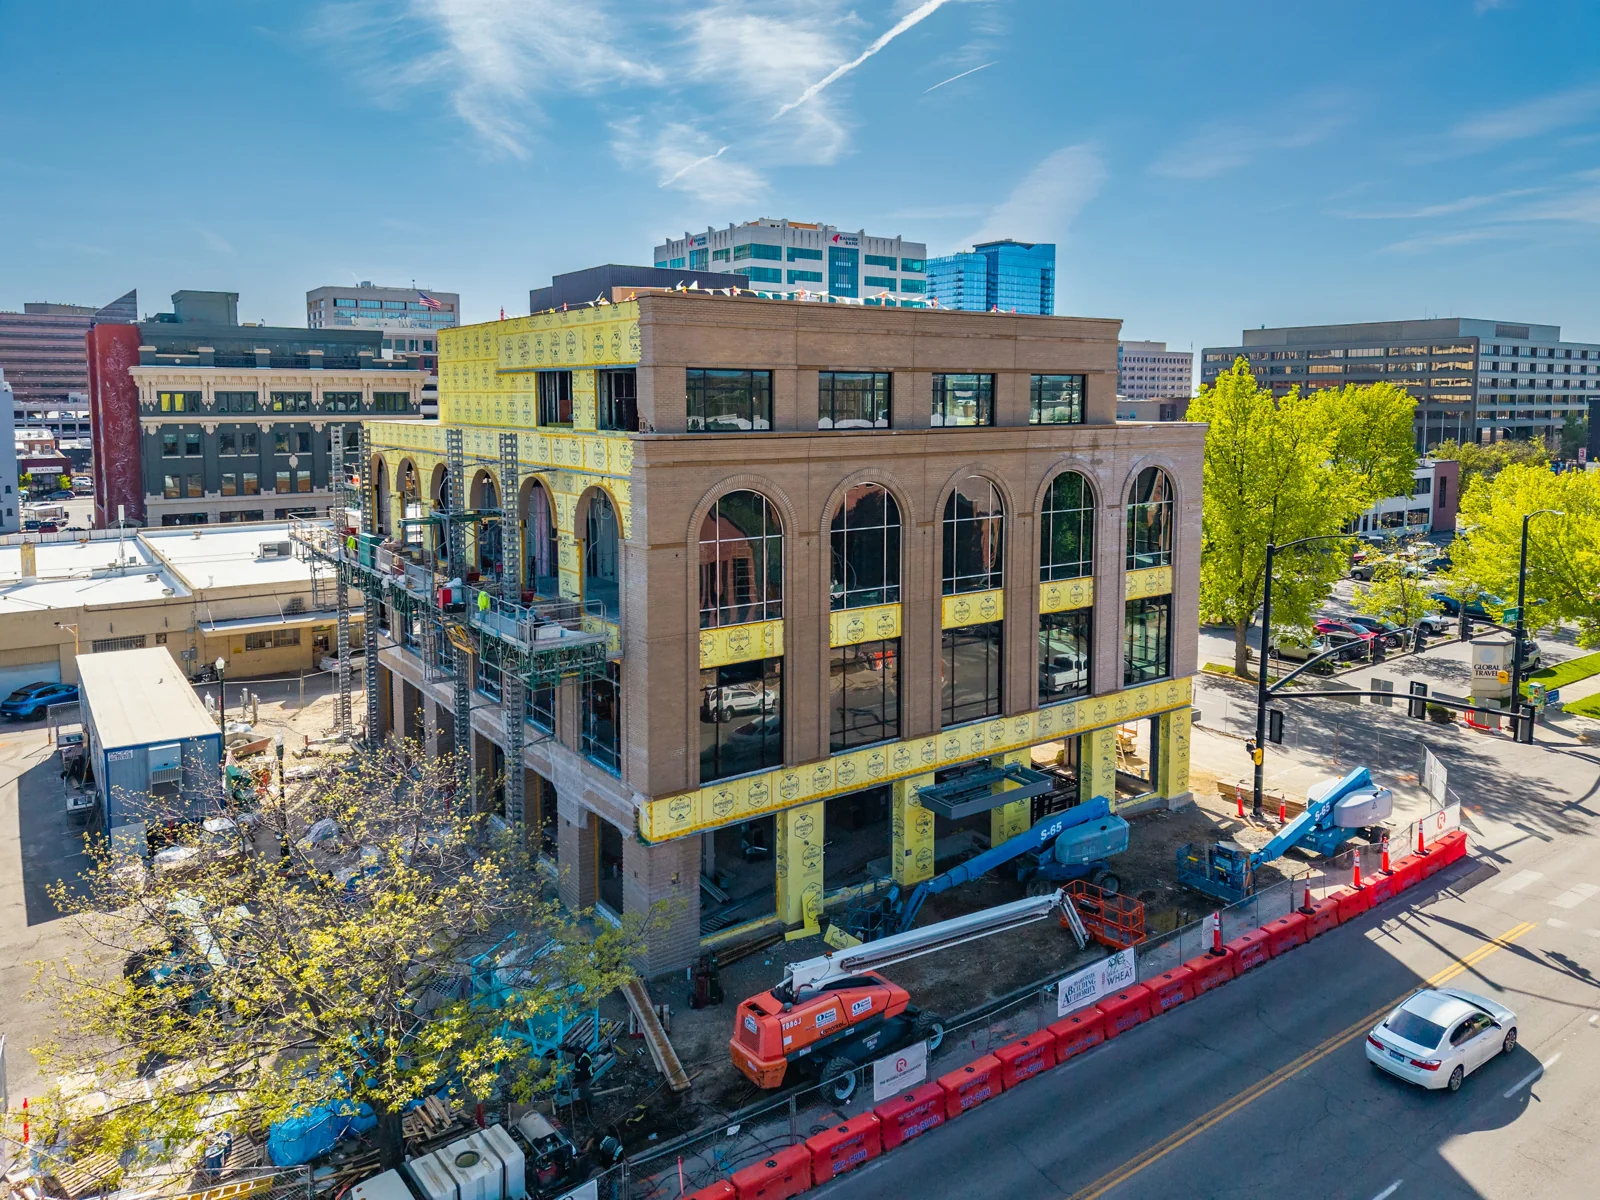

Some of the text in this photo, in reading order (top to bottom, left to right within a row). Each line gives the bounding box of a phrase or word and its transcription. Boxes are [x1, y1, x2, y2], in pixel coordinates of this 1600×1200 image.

[1315, 802, 1331, 821] S-65
[1040, 821, 1062, 840] S-65
[1107, 967, 1133, 986] WHEAT
[1062, 985, 1096, 1006] AUTHORITY
[1067, 979, 1096, 996] BUILDING
